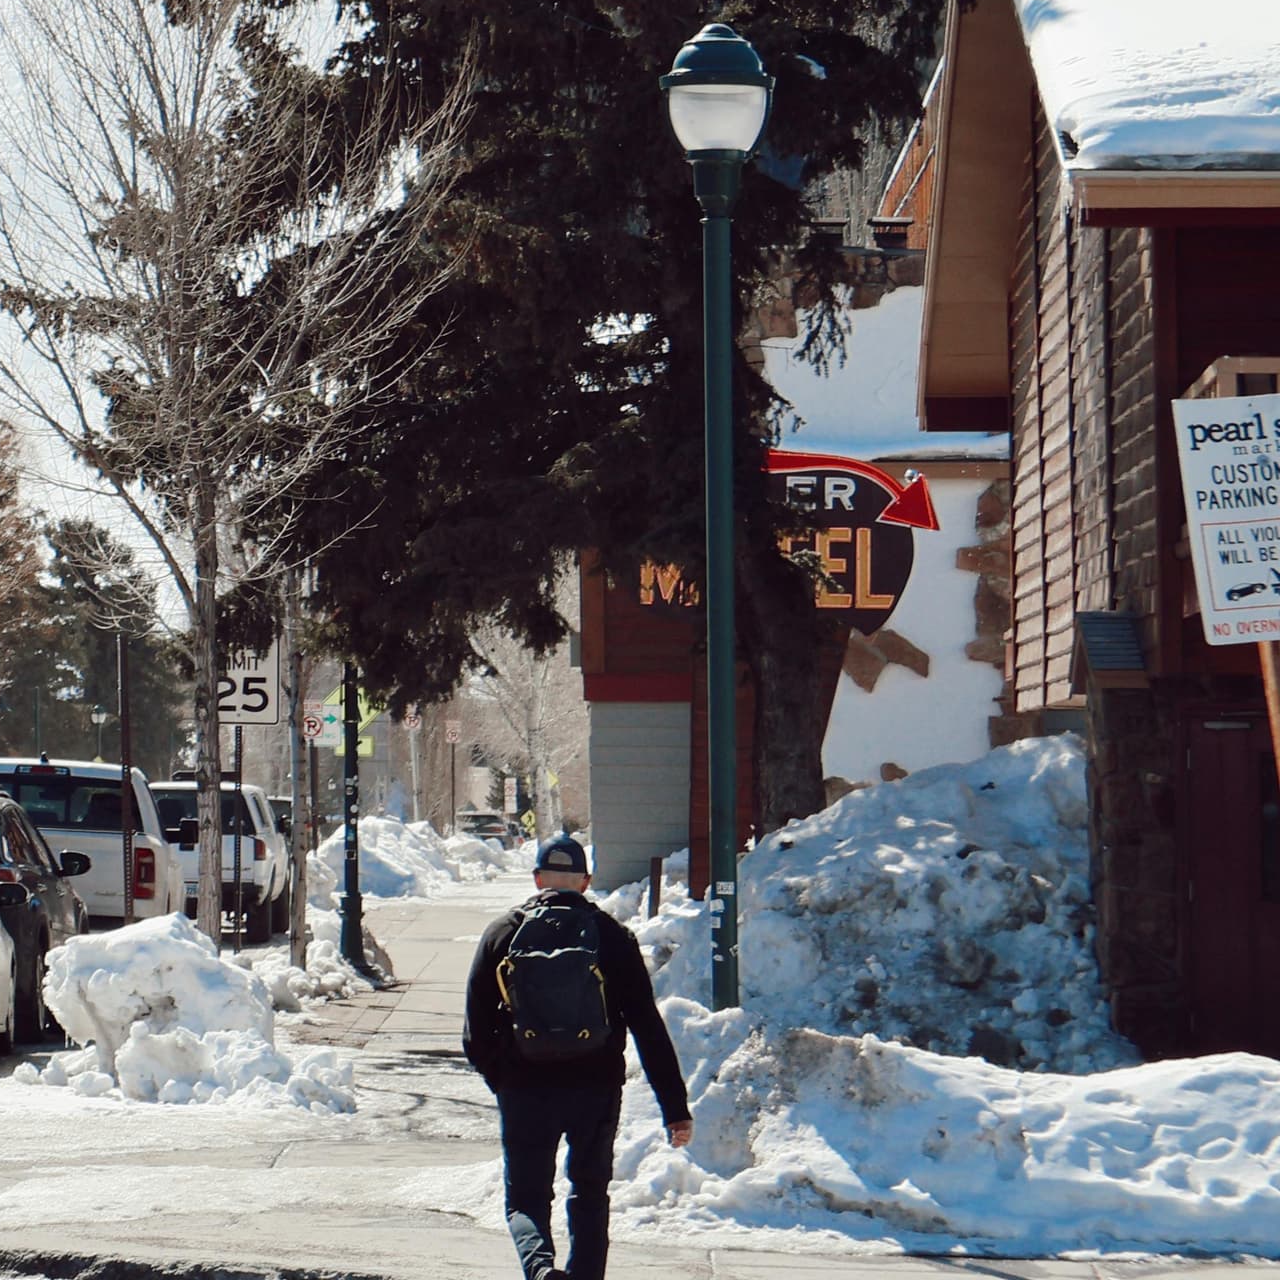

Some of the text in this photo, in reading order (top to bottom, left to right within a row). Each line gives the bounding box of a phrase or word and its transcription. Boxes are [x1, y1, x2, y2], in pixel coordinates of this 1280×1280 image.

[1187, 413, 1267, 450] pearl
[1196, 486, 1278, 510] PARKING
[1218, 529, 1245, 545] ALL
[1218, 546, 1279, 565] WILL BE
[1212, 623, 1231, 636] NO
[226, 654, 260, 671] IMIT
[217, 677, 269, 713] 25
